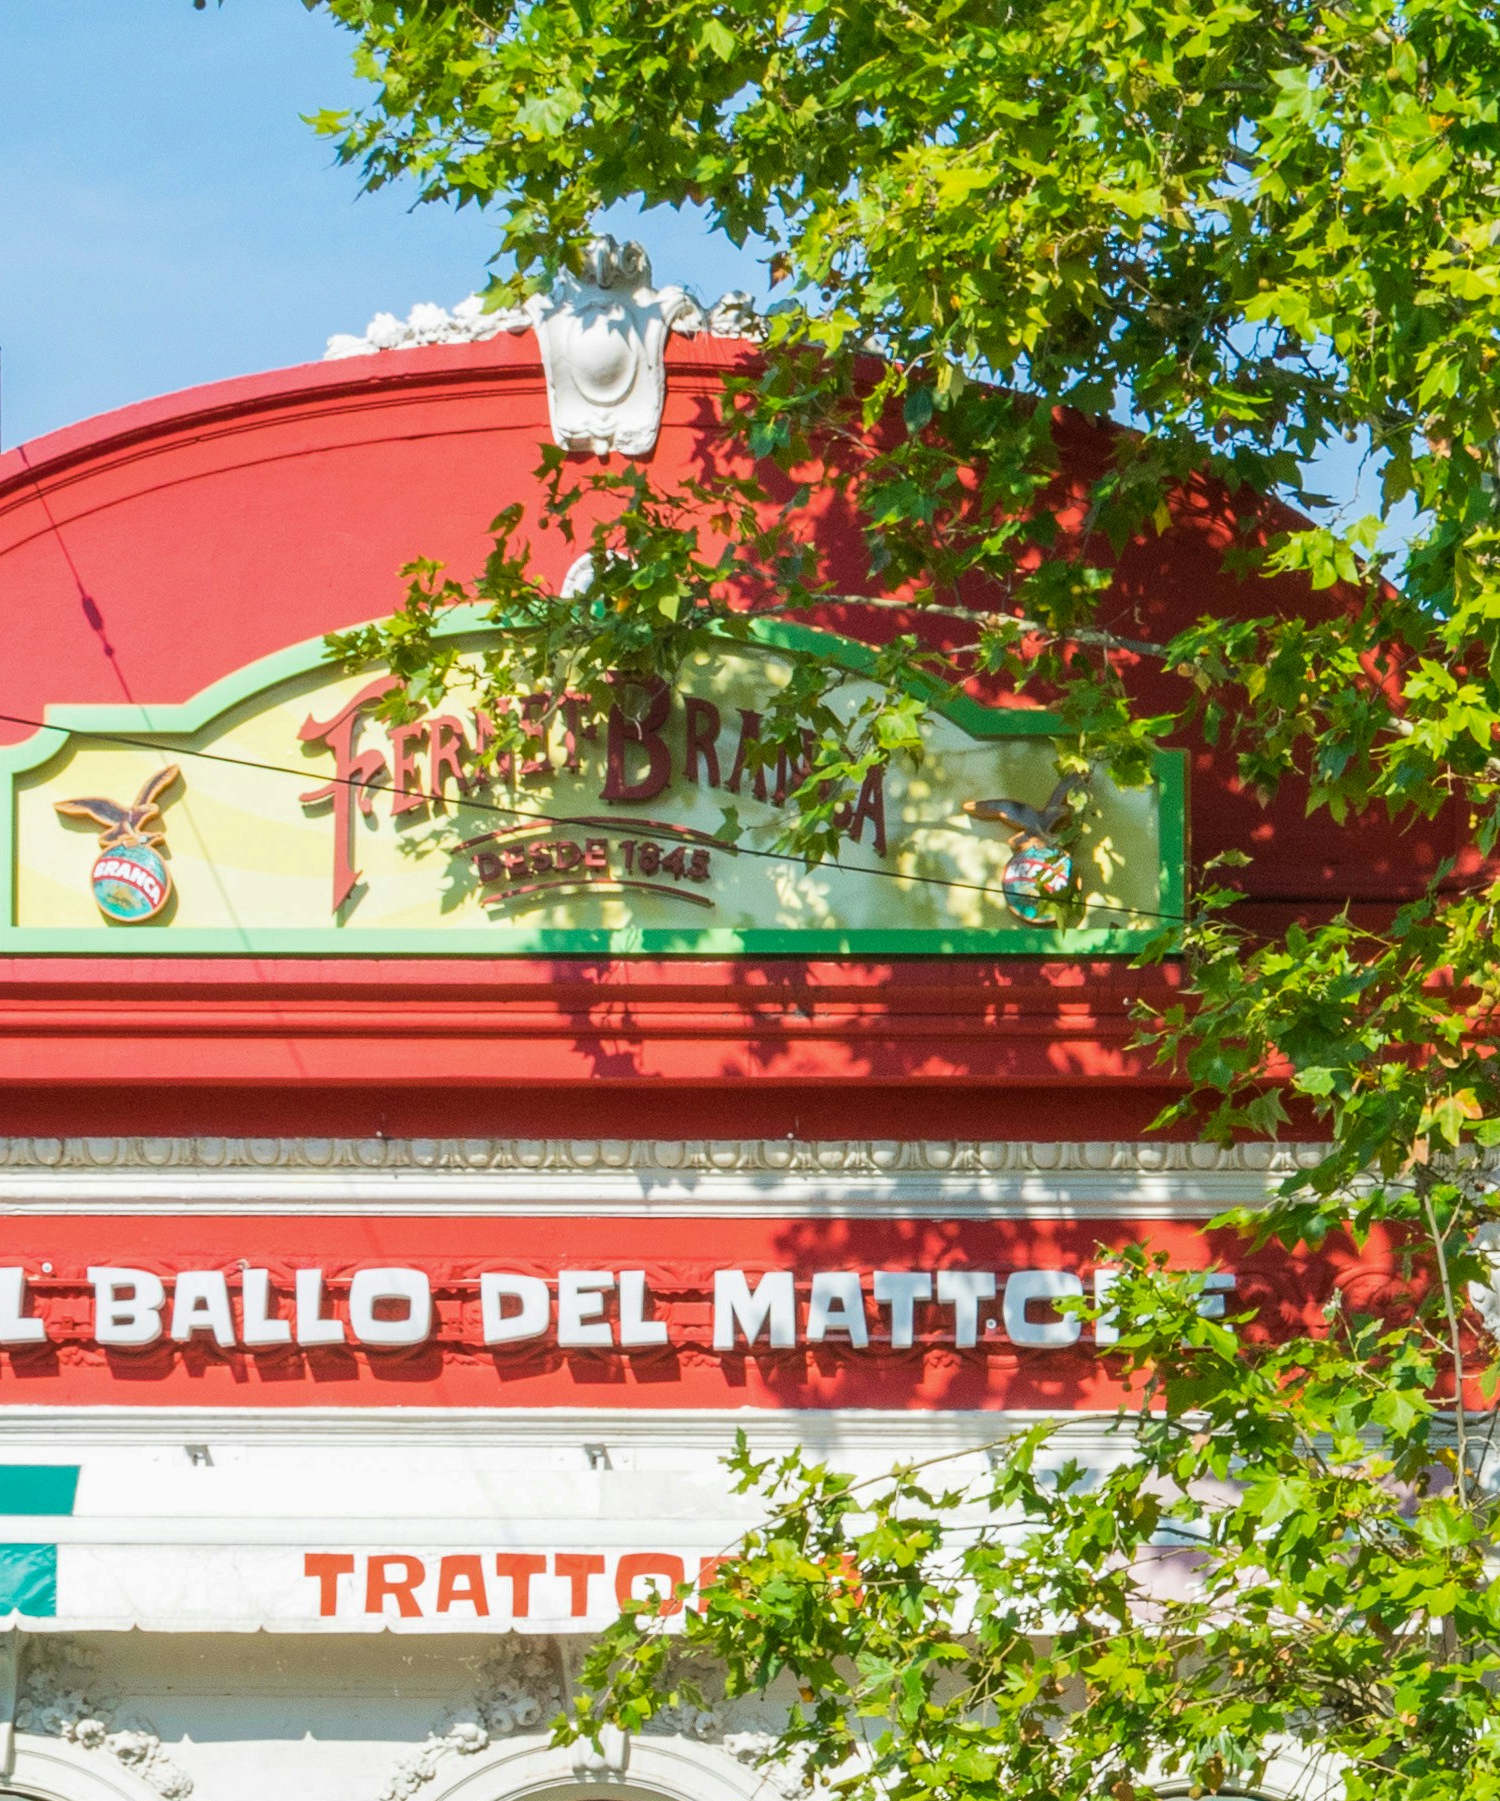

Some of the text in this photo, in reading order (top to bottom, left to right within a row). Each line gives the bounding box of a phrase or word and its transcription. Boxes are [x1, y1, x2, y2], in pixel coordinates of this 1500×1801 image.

[93, 860, 161, 905] BRANCA
[472, 837, 609, 883] DESDE
[87, 1266, 432, 1348] BALLO
[480, 1270, 668, 1349] DEL
